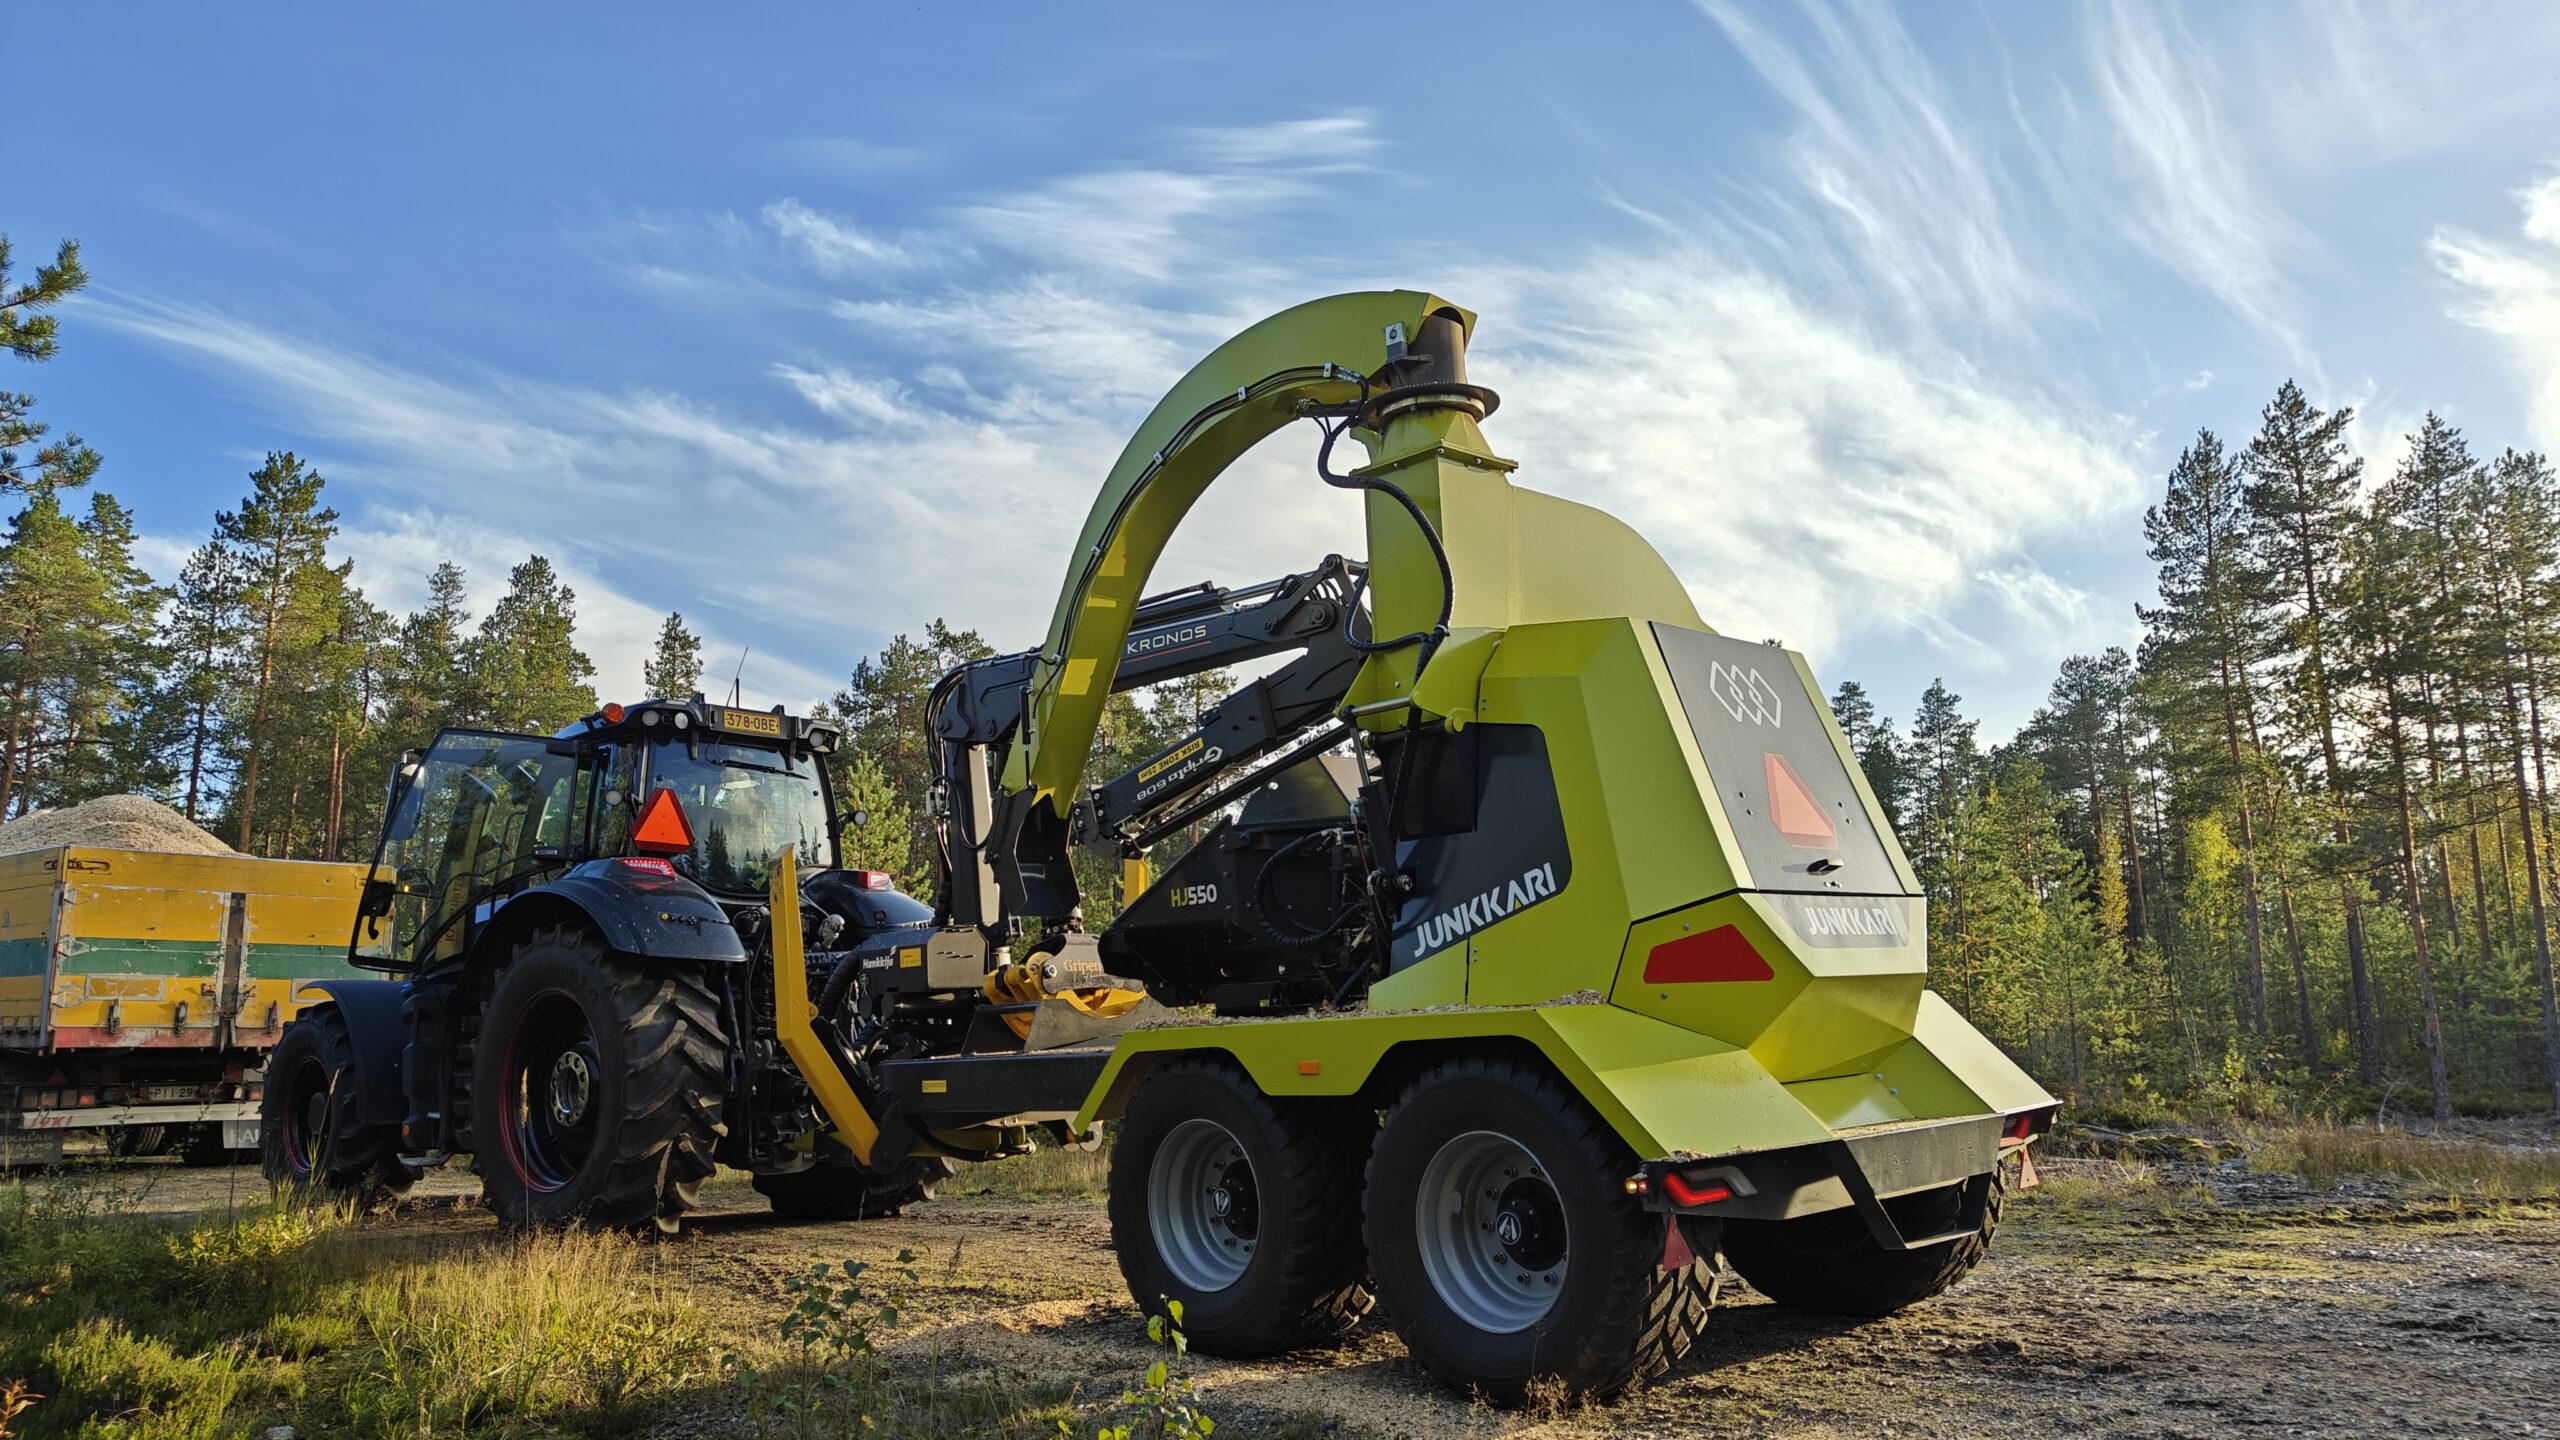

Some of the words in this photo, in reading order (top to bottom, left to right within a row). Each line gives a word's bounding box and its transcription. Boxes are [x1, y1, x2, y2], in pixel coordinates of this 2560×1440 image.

[1127, 624, 1207, 654] KRONOS
[1181, 740, 1201, 756] RISK
[1140, 766, 1157, 779] 25m
[1160, 753, 1180, 770] ZONE
[1168, 745, 1224, 781] Gripto
[1136, 779, 1167, 801] 608
[1170, 883, 1218, 908] HJ550
[1413, 861, 1557, 958] JUNKKARI
[1804, 906, 1898, 936] JUNKKARI
[862, 956, 894, 970] Hankkija
[1062, 959, 1103, 975] Gripen
